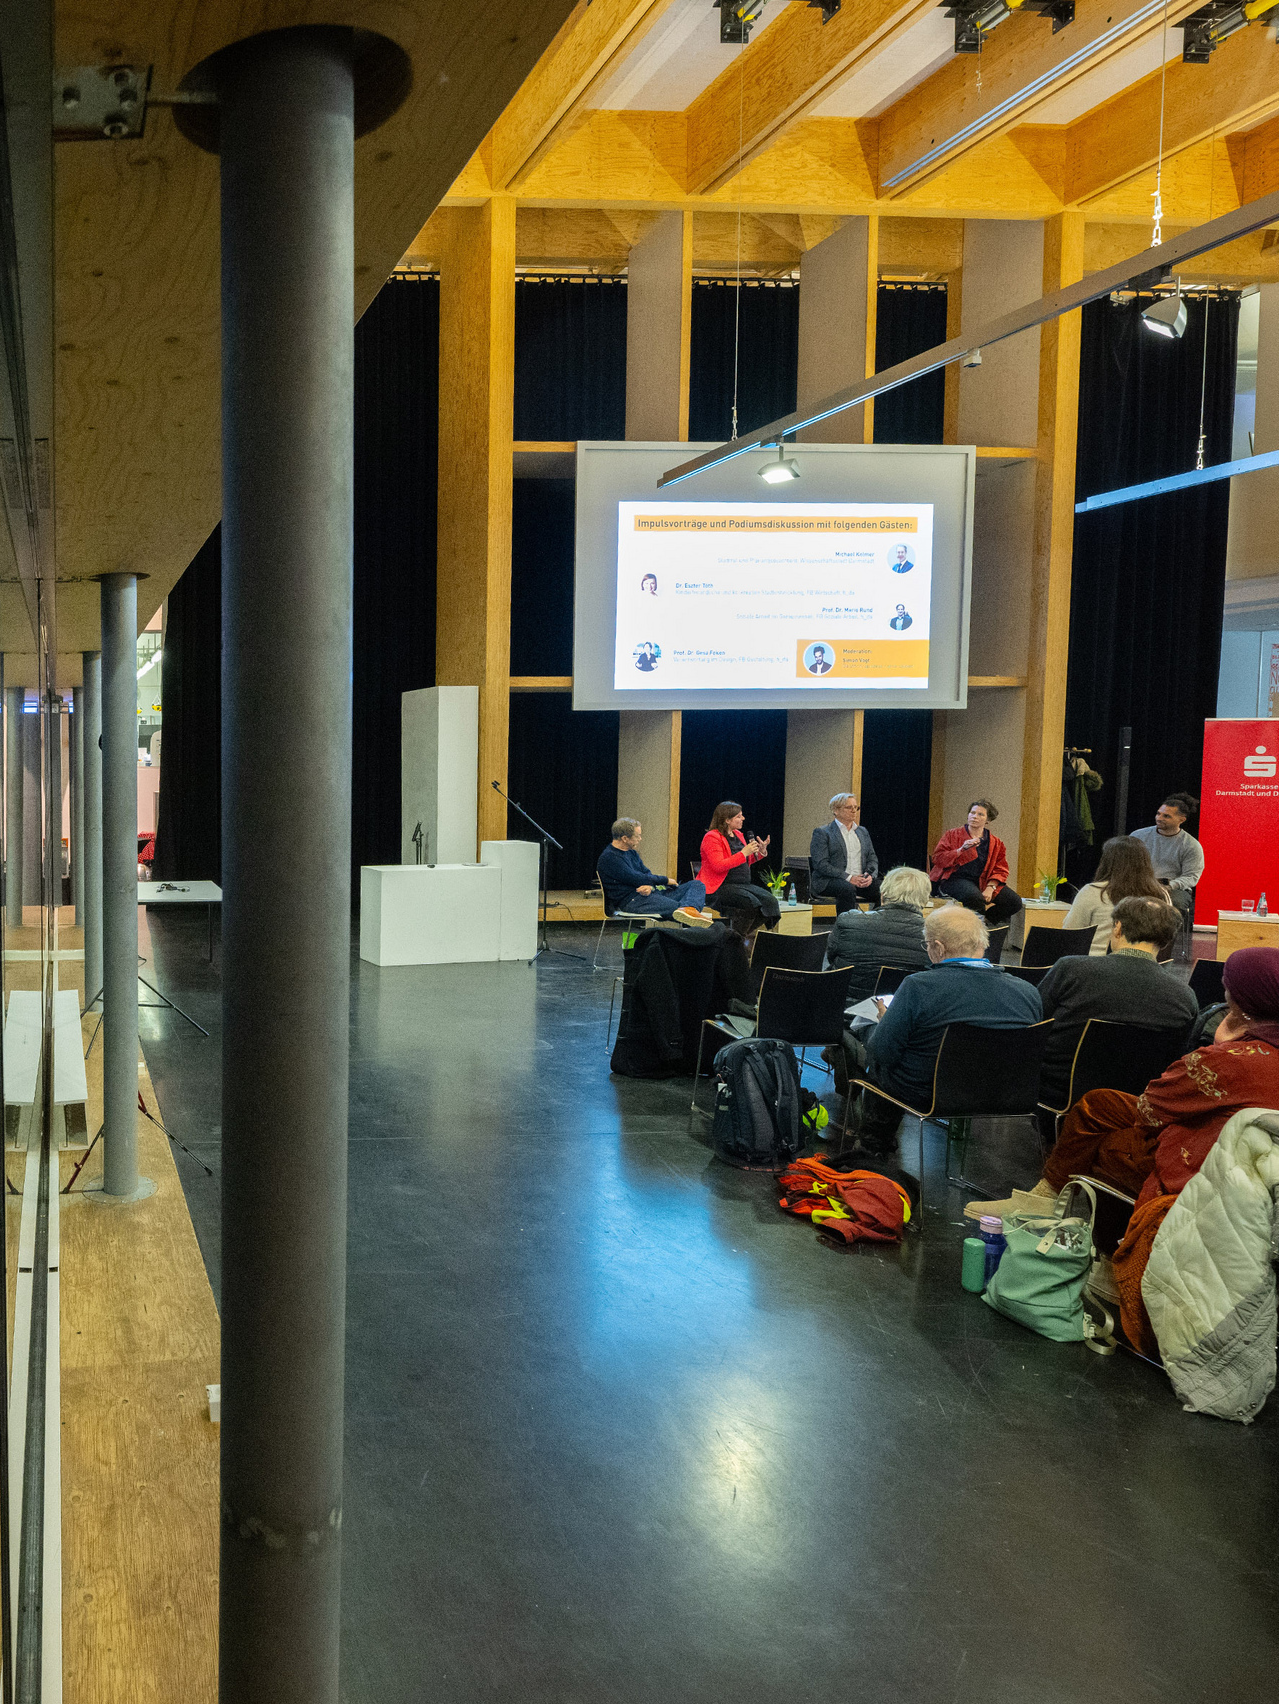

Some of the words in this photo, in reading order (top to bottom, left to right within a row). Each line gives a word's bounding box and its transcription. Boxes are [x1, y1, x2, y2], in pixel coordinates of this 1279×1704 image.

[638, 519, 707, 529] Impulsvorträge
[710, 520, 726, 528] und
[729, 520, 814, 528] Podiumsdiskussion
[833, 521, 877, 530] folgenden
[879, 521, 913, 529] Gästen:
